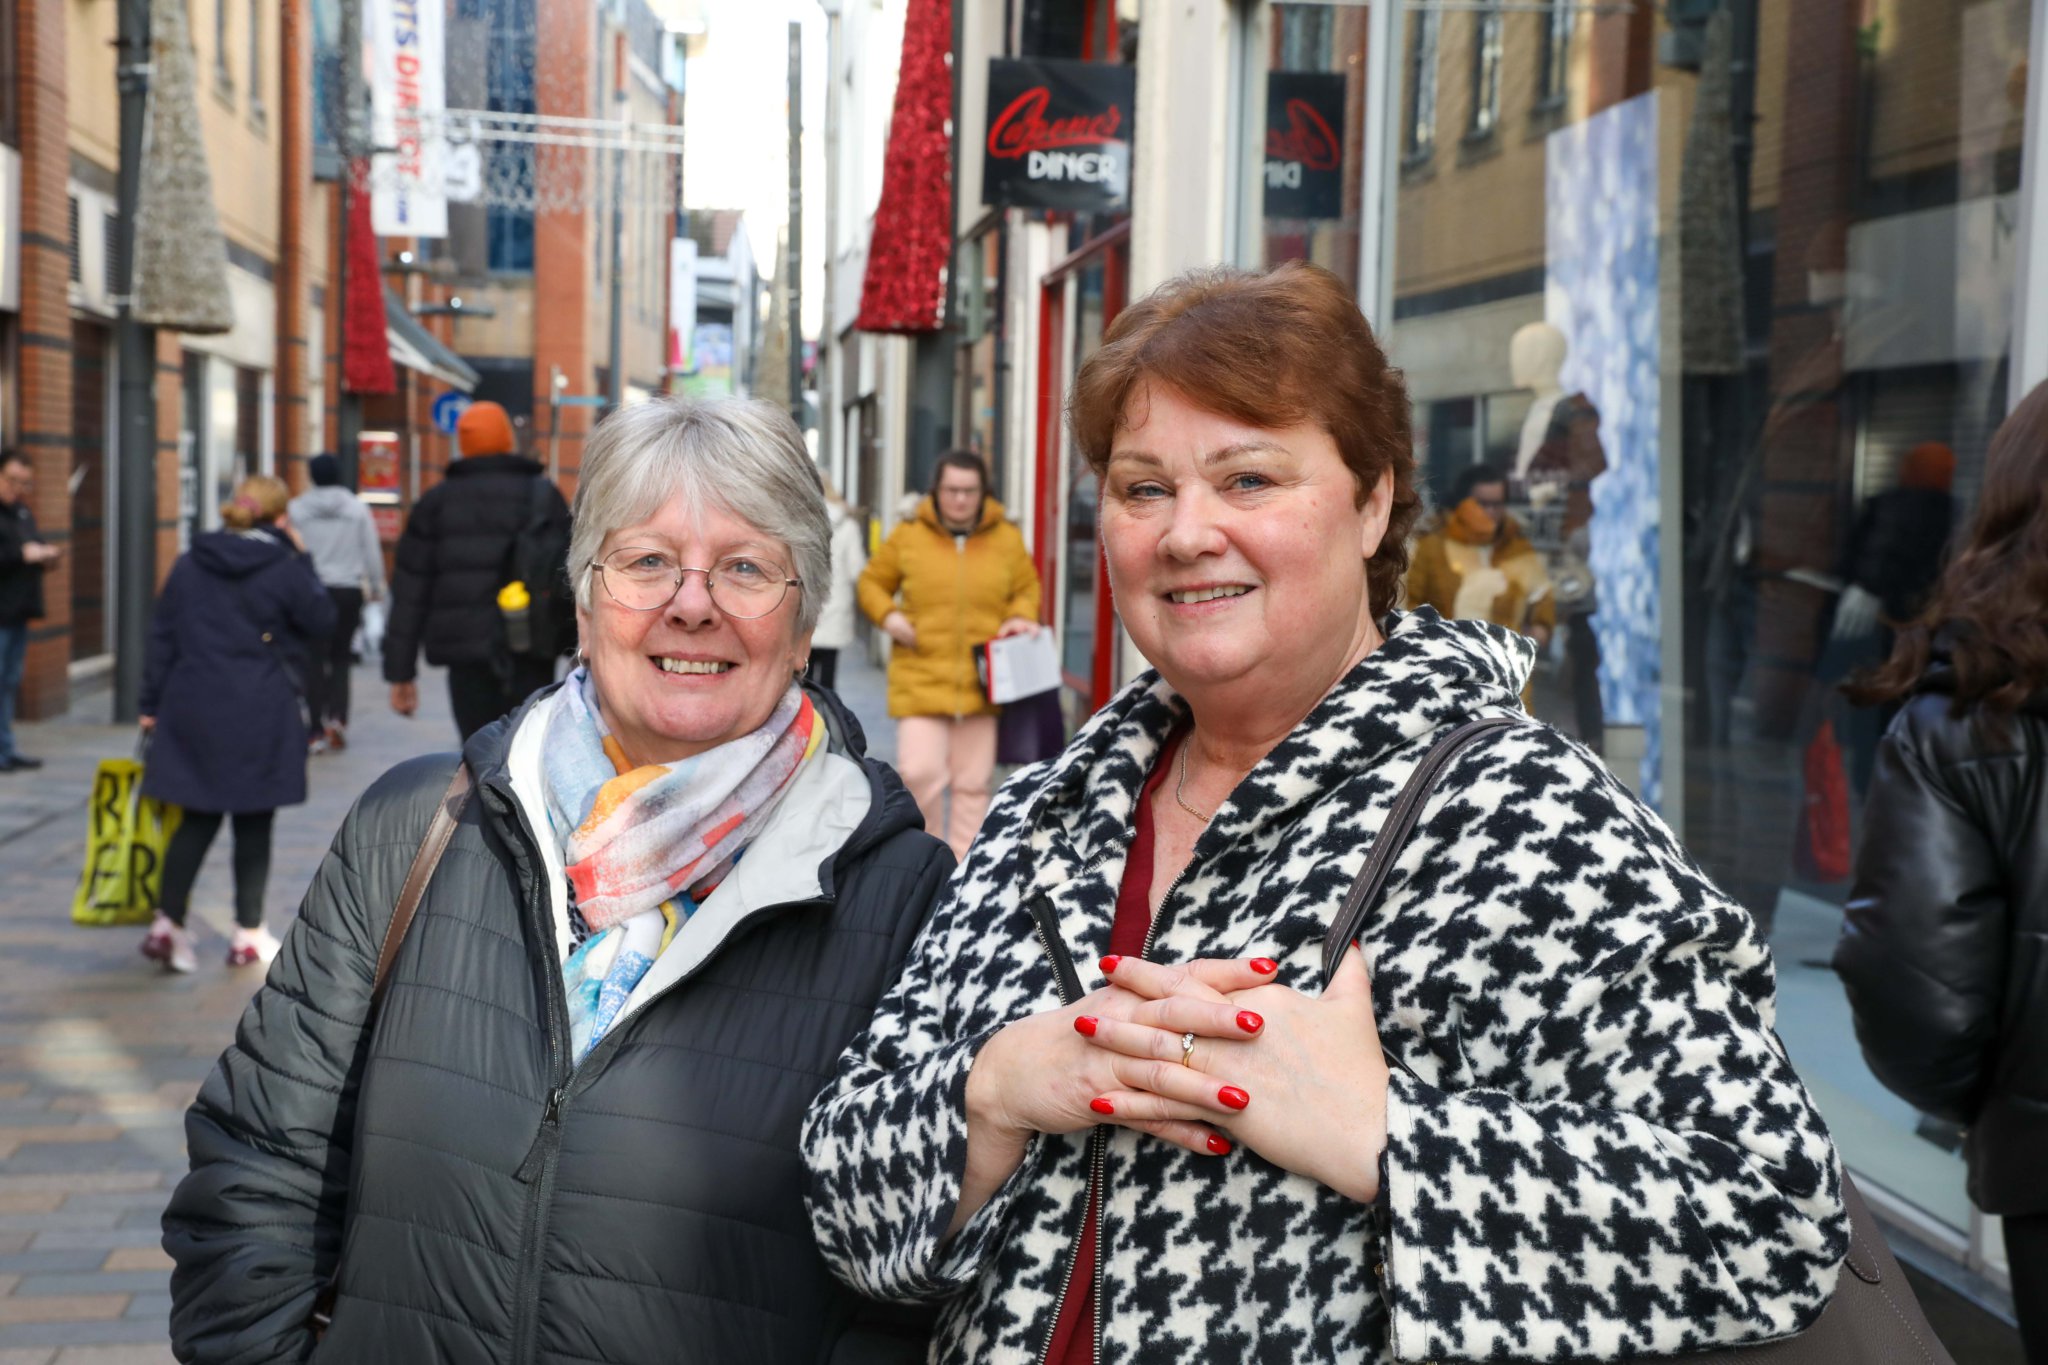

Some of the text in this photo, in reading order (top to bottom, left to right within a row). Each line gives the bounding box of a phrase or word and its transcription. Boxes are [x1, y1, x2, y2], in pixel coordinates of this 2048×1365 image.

[394, 0, 418, 47] TS
[394, 55, 420, 179] DIRECT
[1027, 150, 1118, 183] DINER
